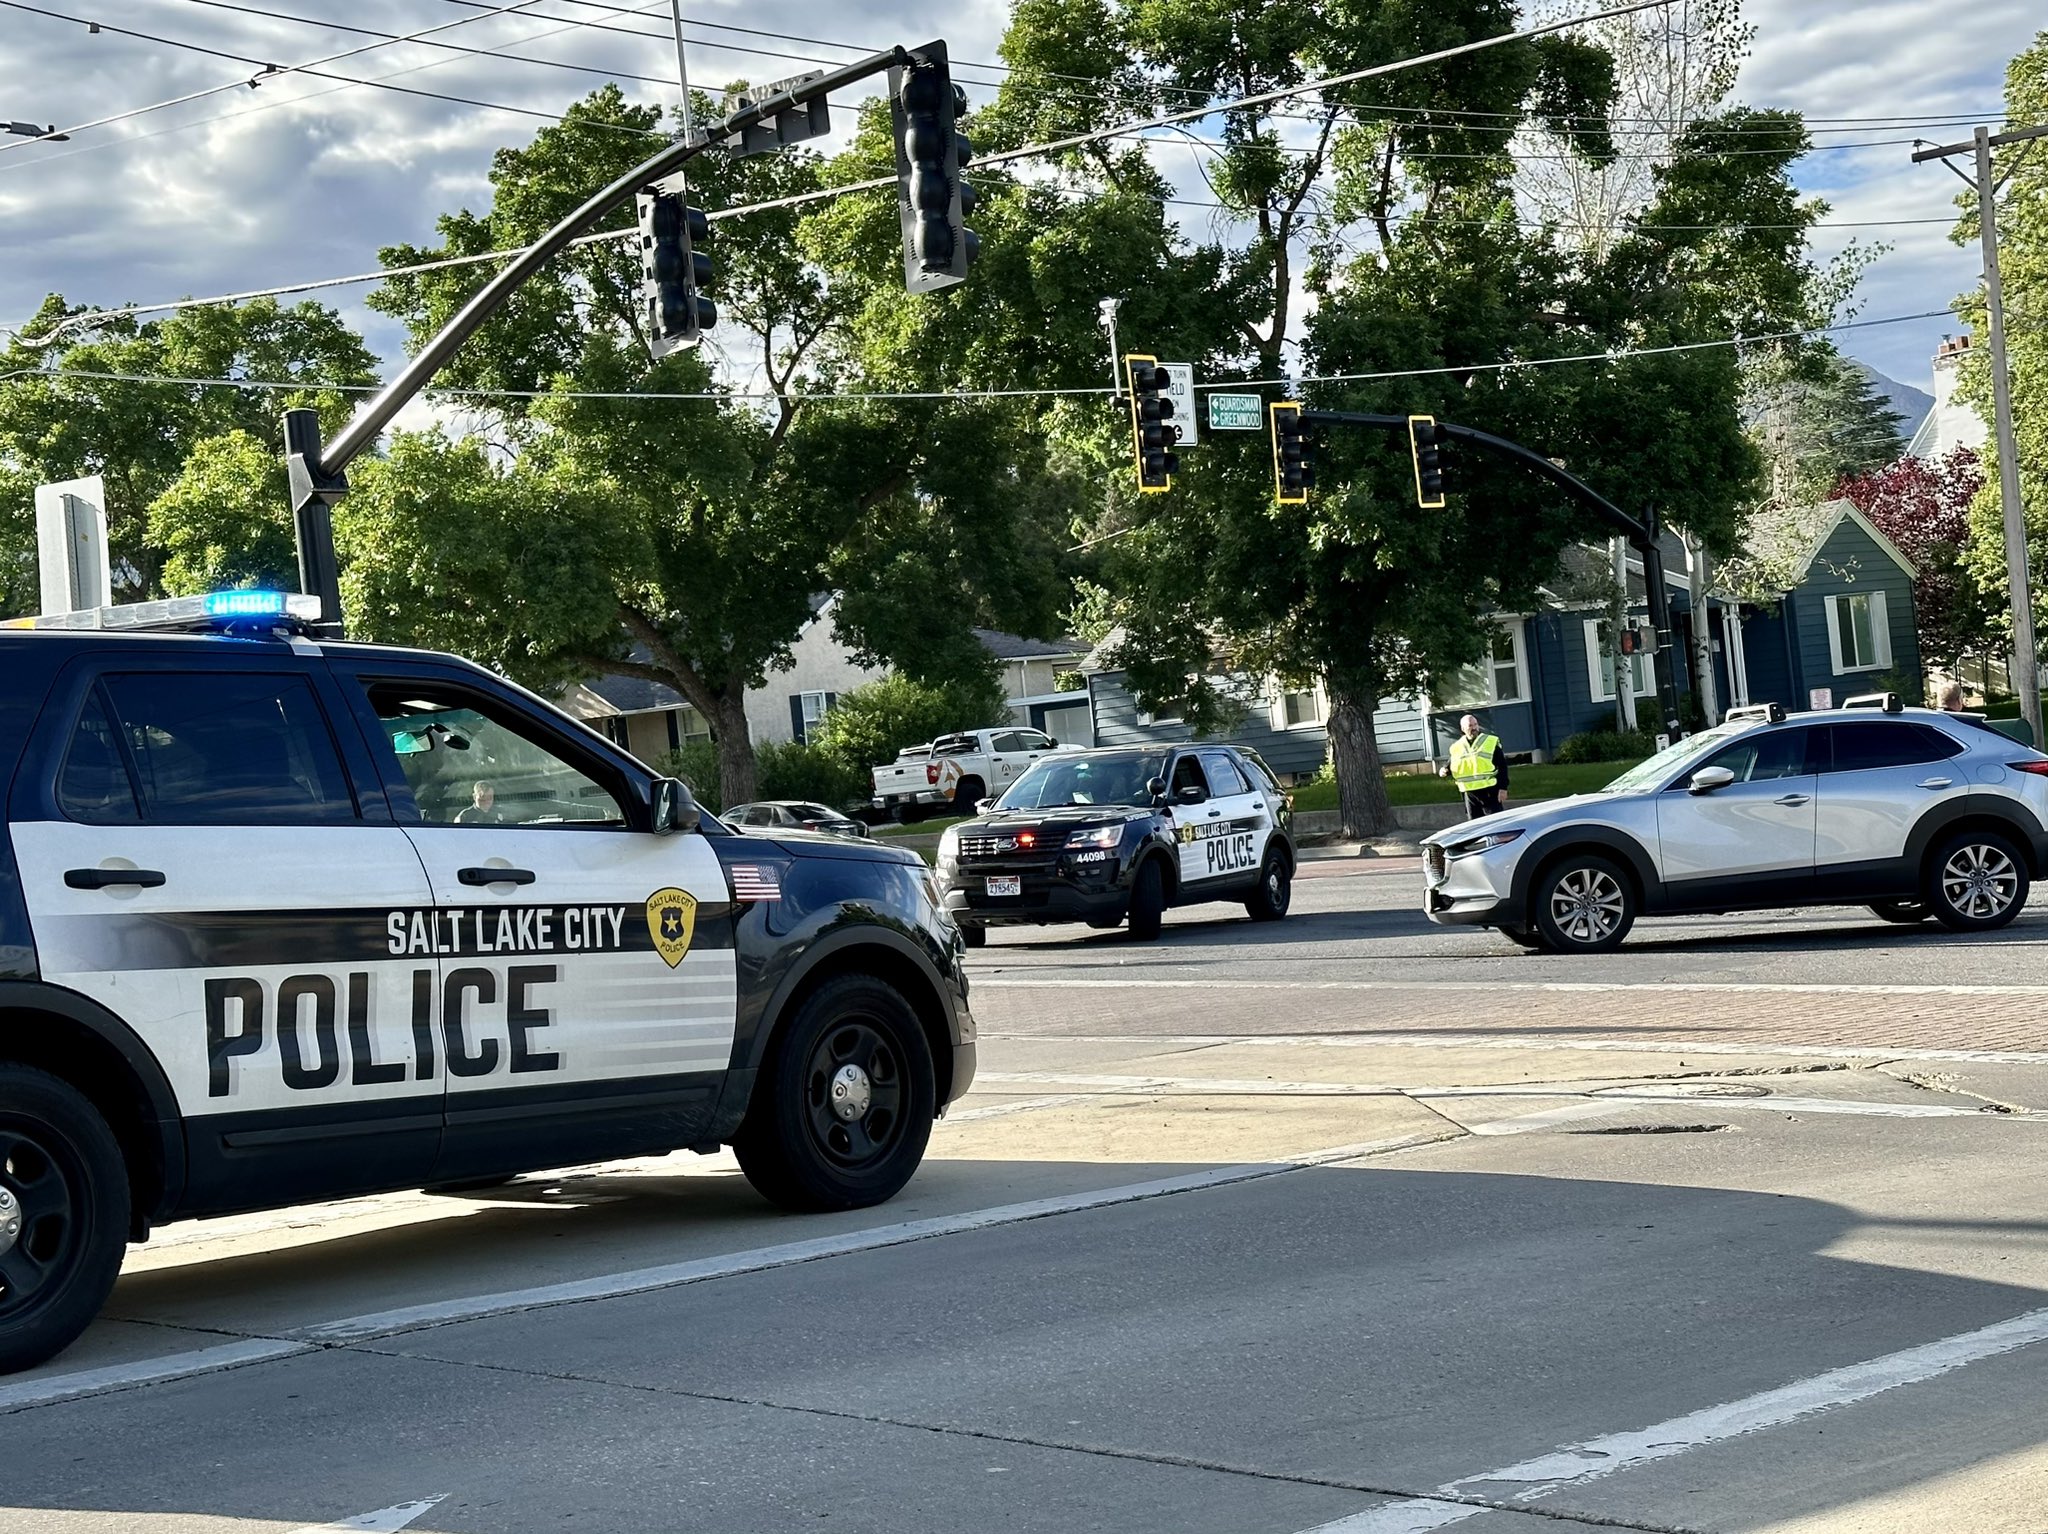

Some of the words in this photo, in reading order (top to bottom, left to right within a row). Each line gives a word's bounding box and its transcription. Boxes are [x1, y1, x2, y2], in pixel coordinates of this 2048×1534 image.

[1219, 397, 1259, 412] GUARDSMAN
[1219, 412, 1260, 427] GREENWOOD
[1221, 821, 1232, 835] CITY
[1076, 851, 1106, 864] 44098
[1206, 834, 1257, 874] POLICE
[649, 896, 664, 911] SALT
[664, 894, 681, 903] LAKE
[681, 896, 695, 910] CITY
[387, 911, 465, 954] SALT
[475, 908, 554, 951] LAKE
[564, 907, 626, 949] CITY
[660, 941, 685, 953] POLICE
[204, 964, 562, 1098] POLICE
